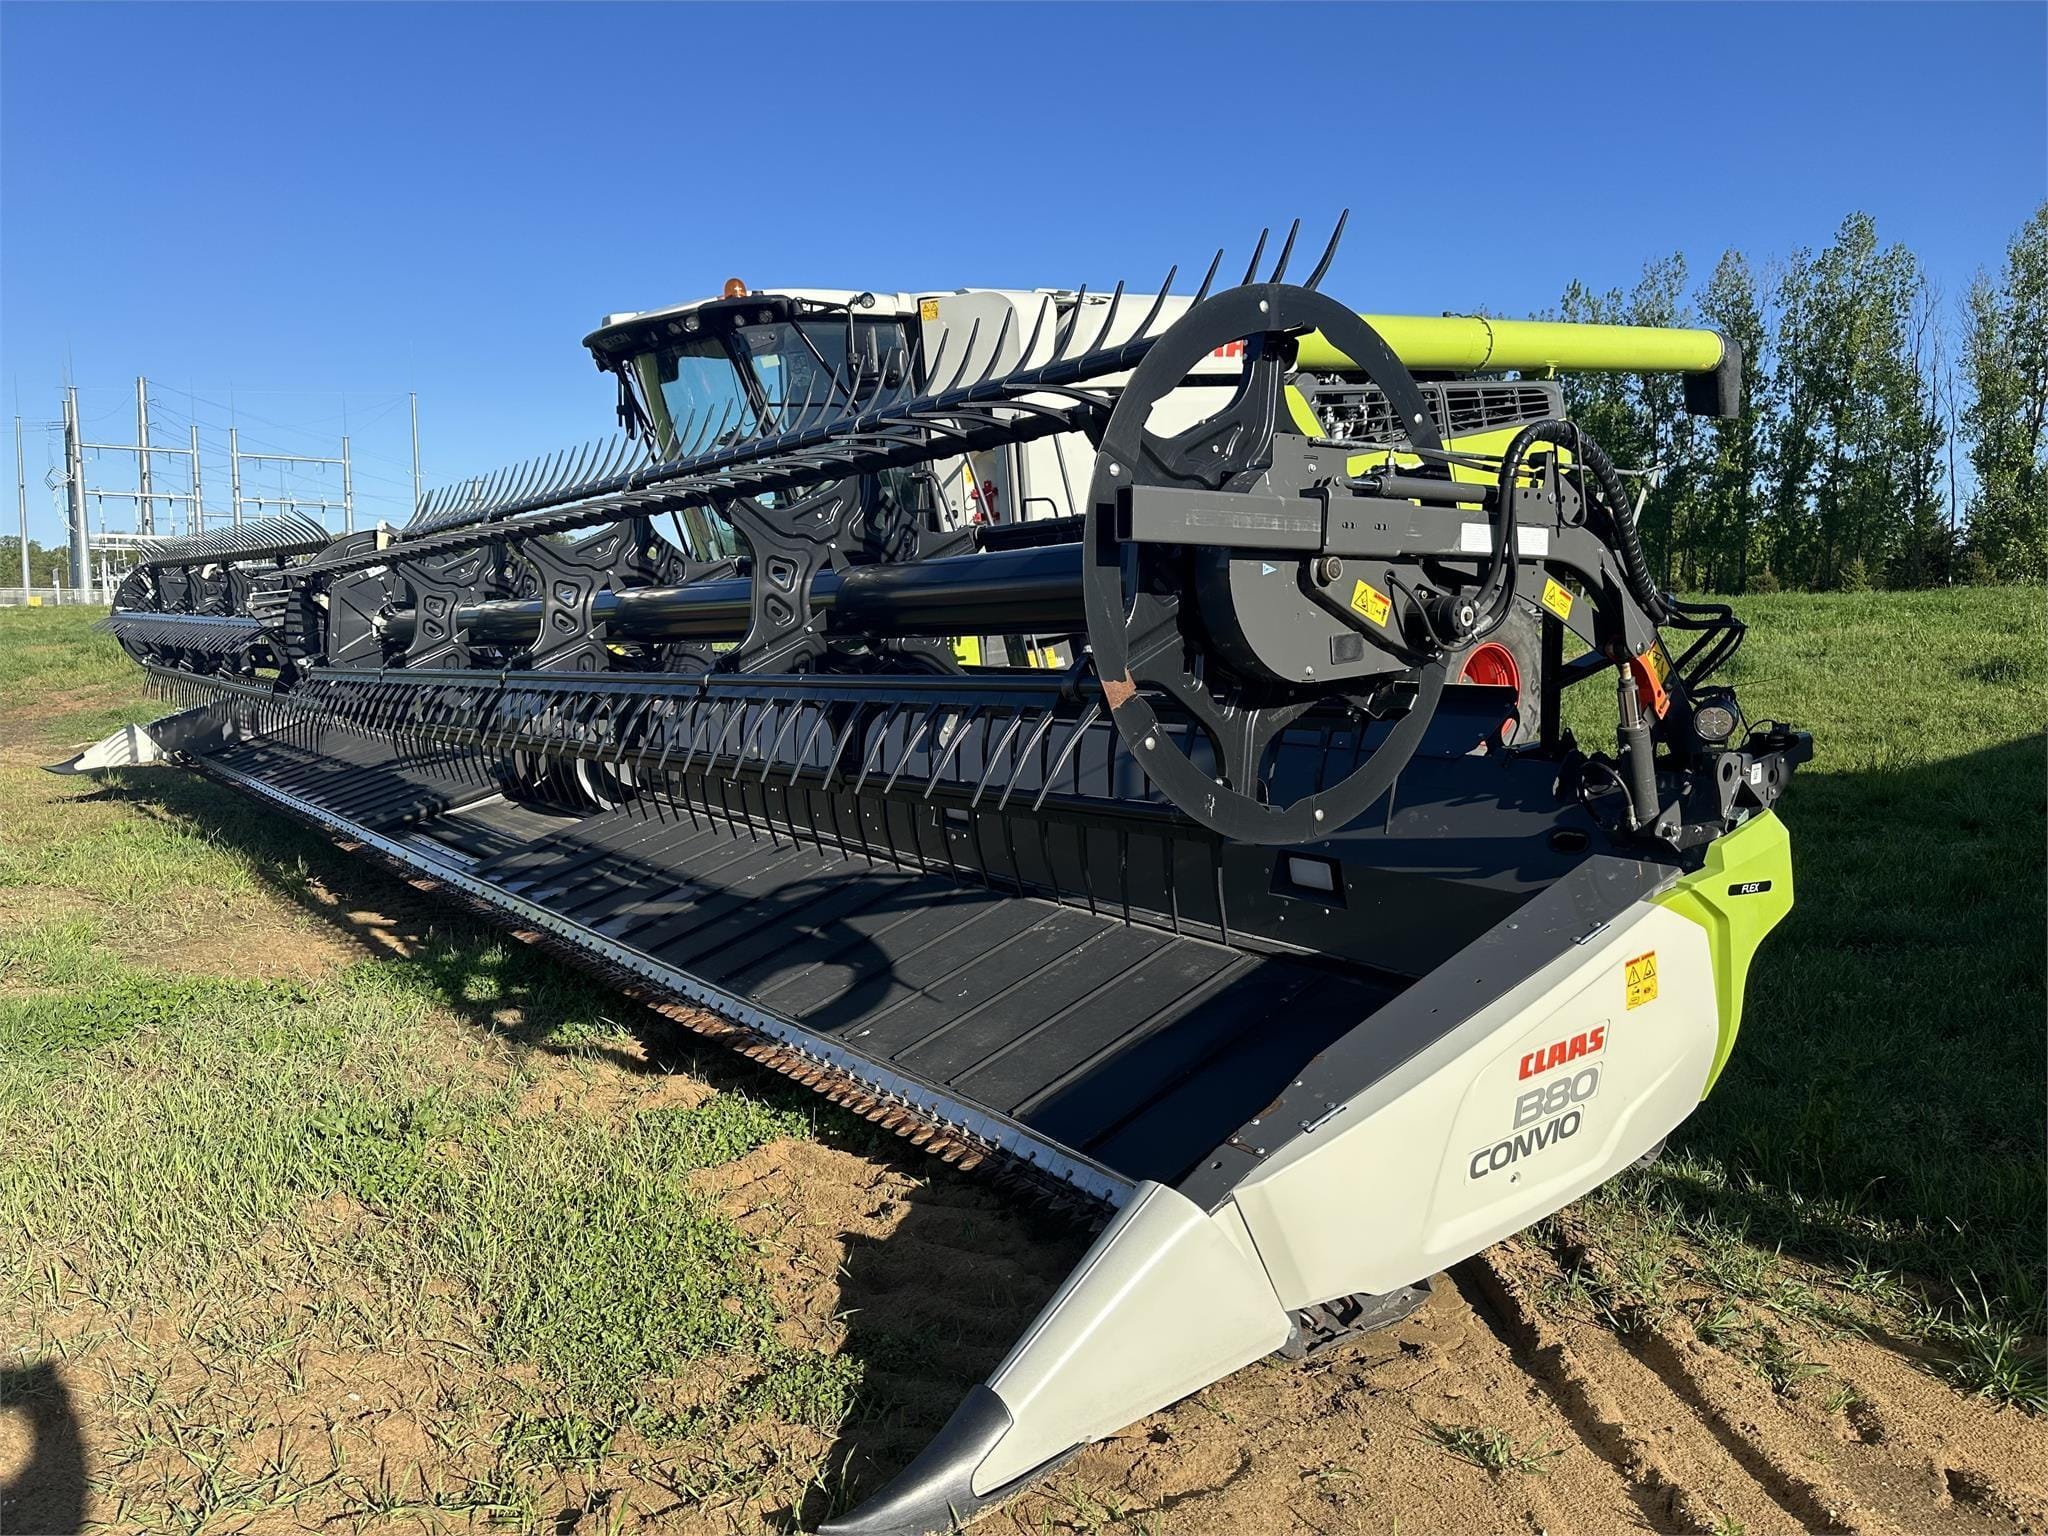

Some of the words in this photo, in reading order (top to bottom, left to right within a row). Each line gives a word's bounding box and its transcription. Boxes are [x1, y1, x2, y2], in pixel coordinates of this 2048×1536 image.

[1741, 882, 1760, 894] FLEX
[1518, 1026, 1605, 1080] CLAAS
[1513, 1067, 1599, 1130] B80
[1469, 1110, 1581, 1180] CONVIO
